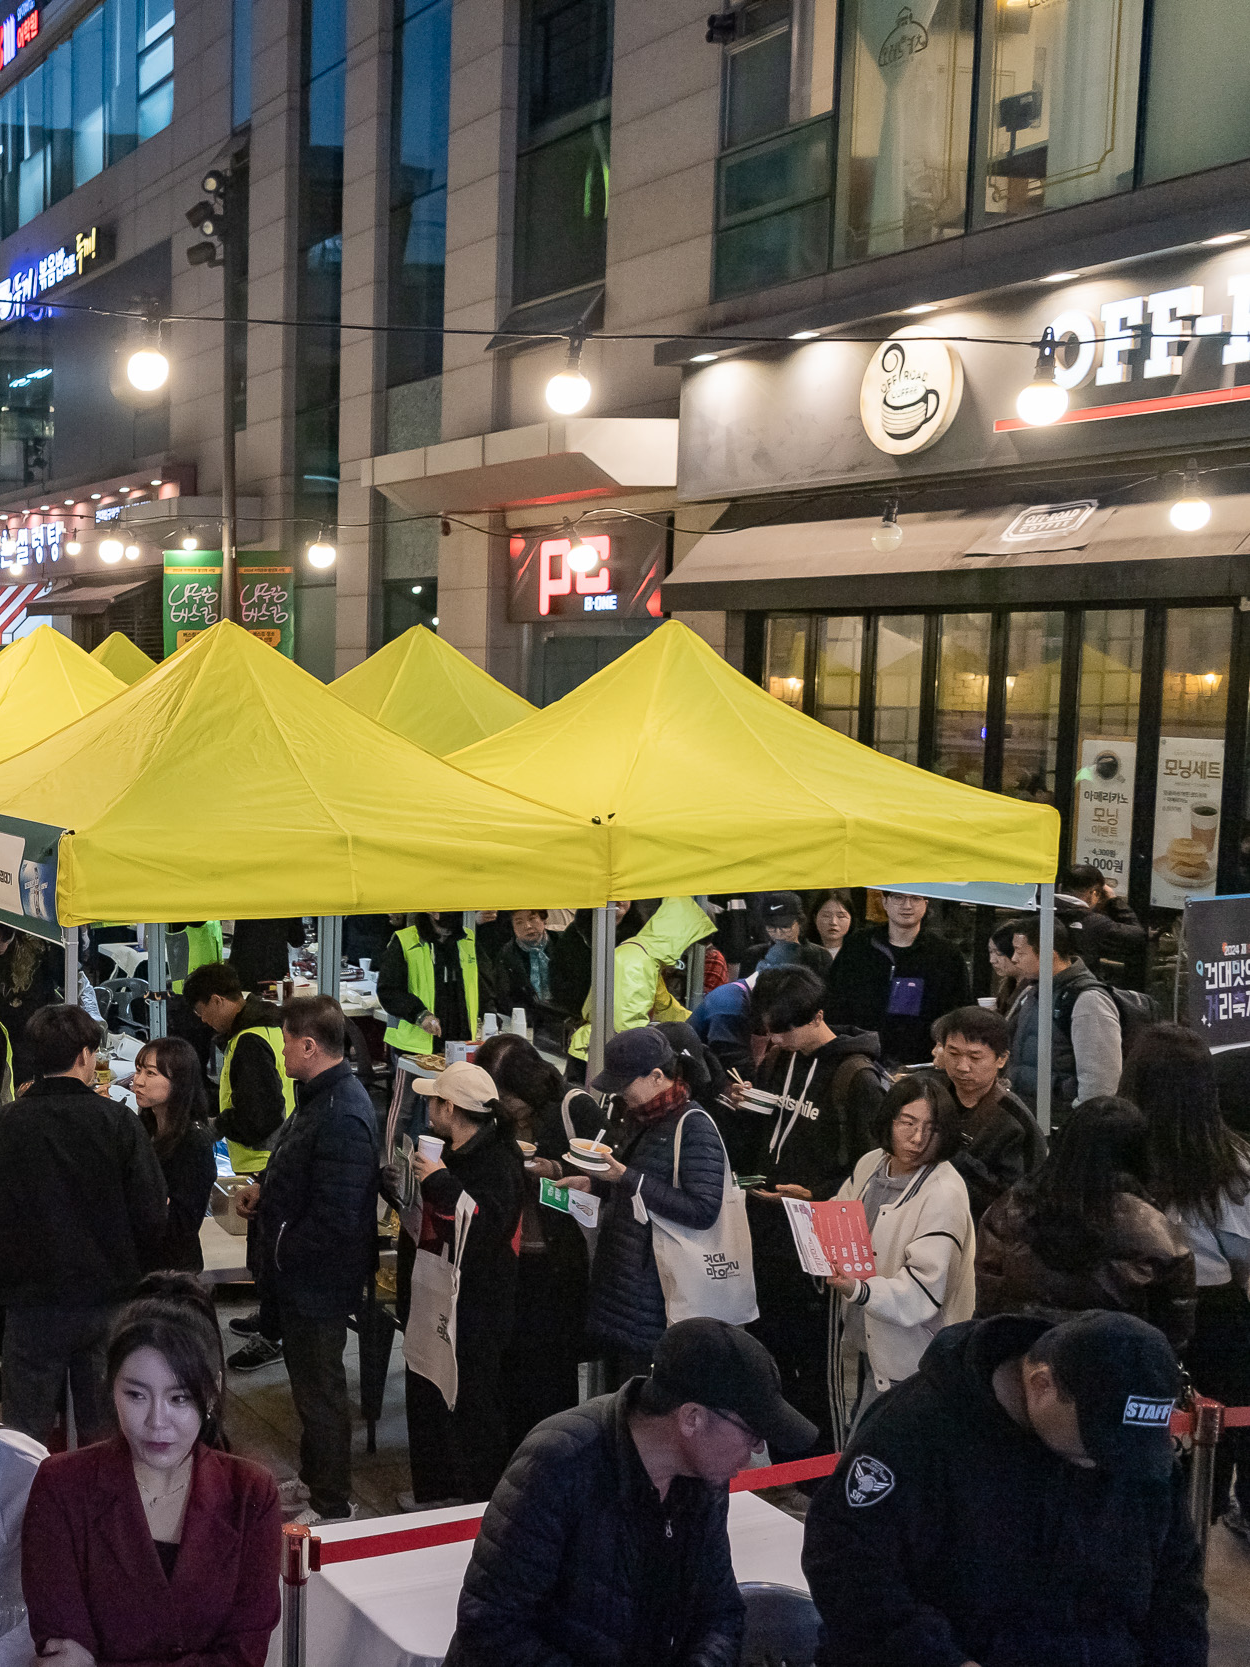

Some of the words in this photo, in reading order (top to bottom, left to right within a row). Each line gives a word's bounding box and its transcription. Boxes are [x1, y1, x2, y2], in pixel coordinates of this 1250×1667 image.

[1025, 508, 1081, 524] OFF-ROAD
[1018, 520, 1070, 533] COFFEE
[170, 604, 218, 624] 버스킹
[241, 604, 288, 624] 버스킹
[1163, 759, 1221, 779] 모닝세트
[1084, 790, 1129, 804] 아메리카노
[1092, 808, 1119, 825] 모닝
[1092, 825, 1118, 837] 이벤트
[1083, 857, 1123, 873] 3000원
[1224, 944, 1240, 956] 2024
[1126, 1402, 1170, 1420] STAFF
[850, 1489, 866, 1503] SRT
